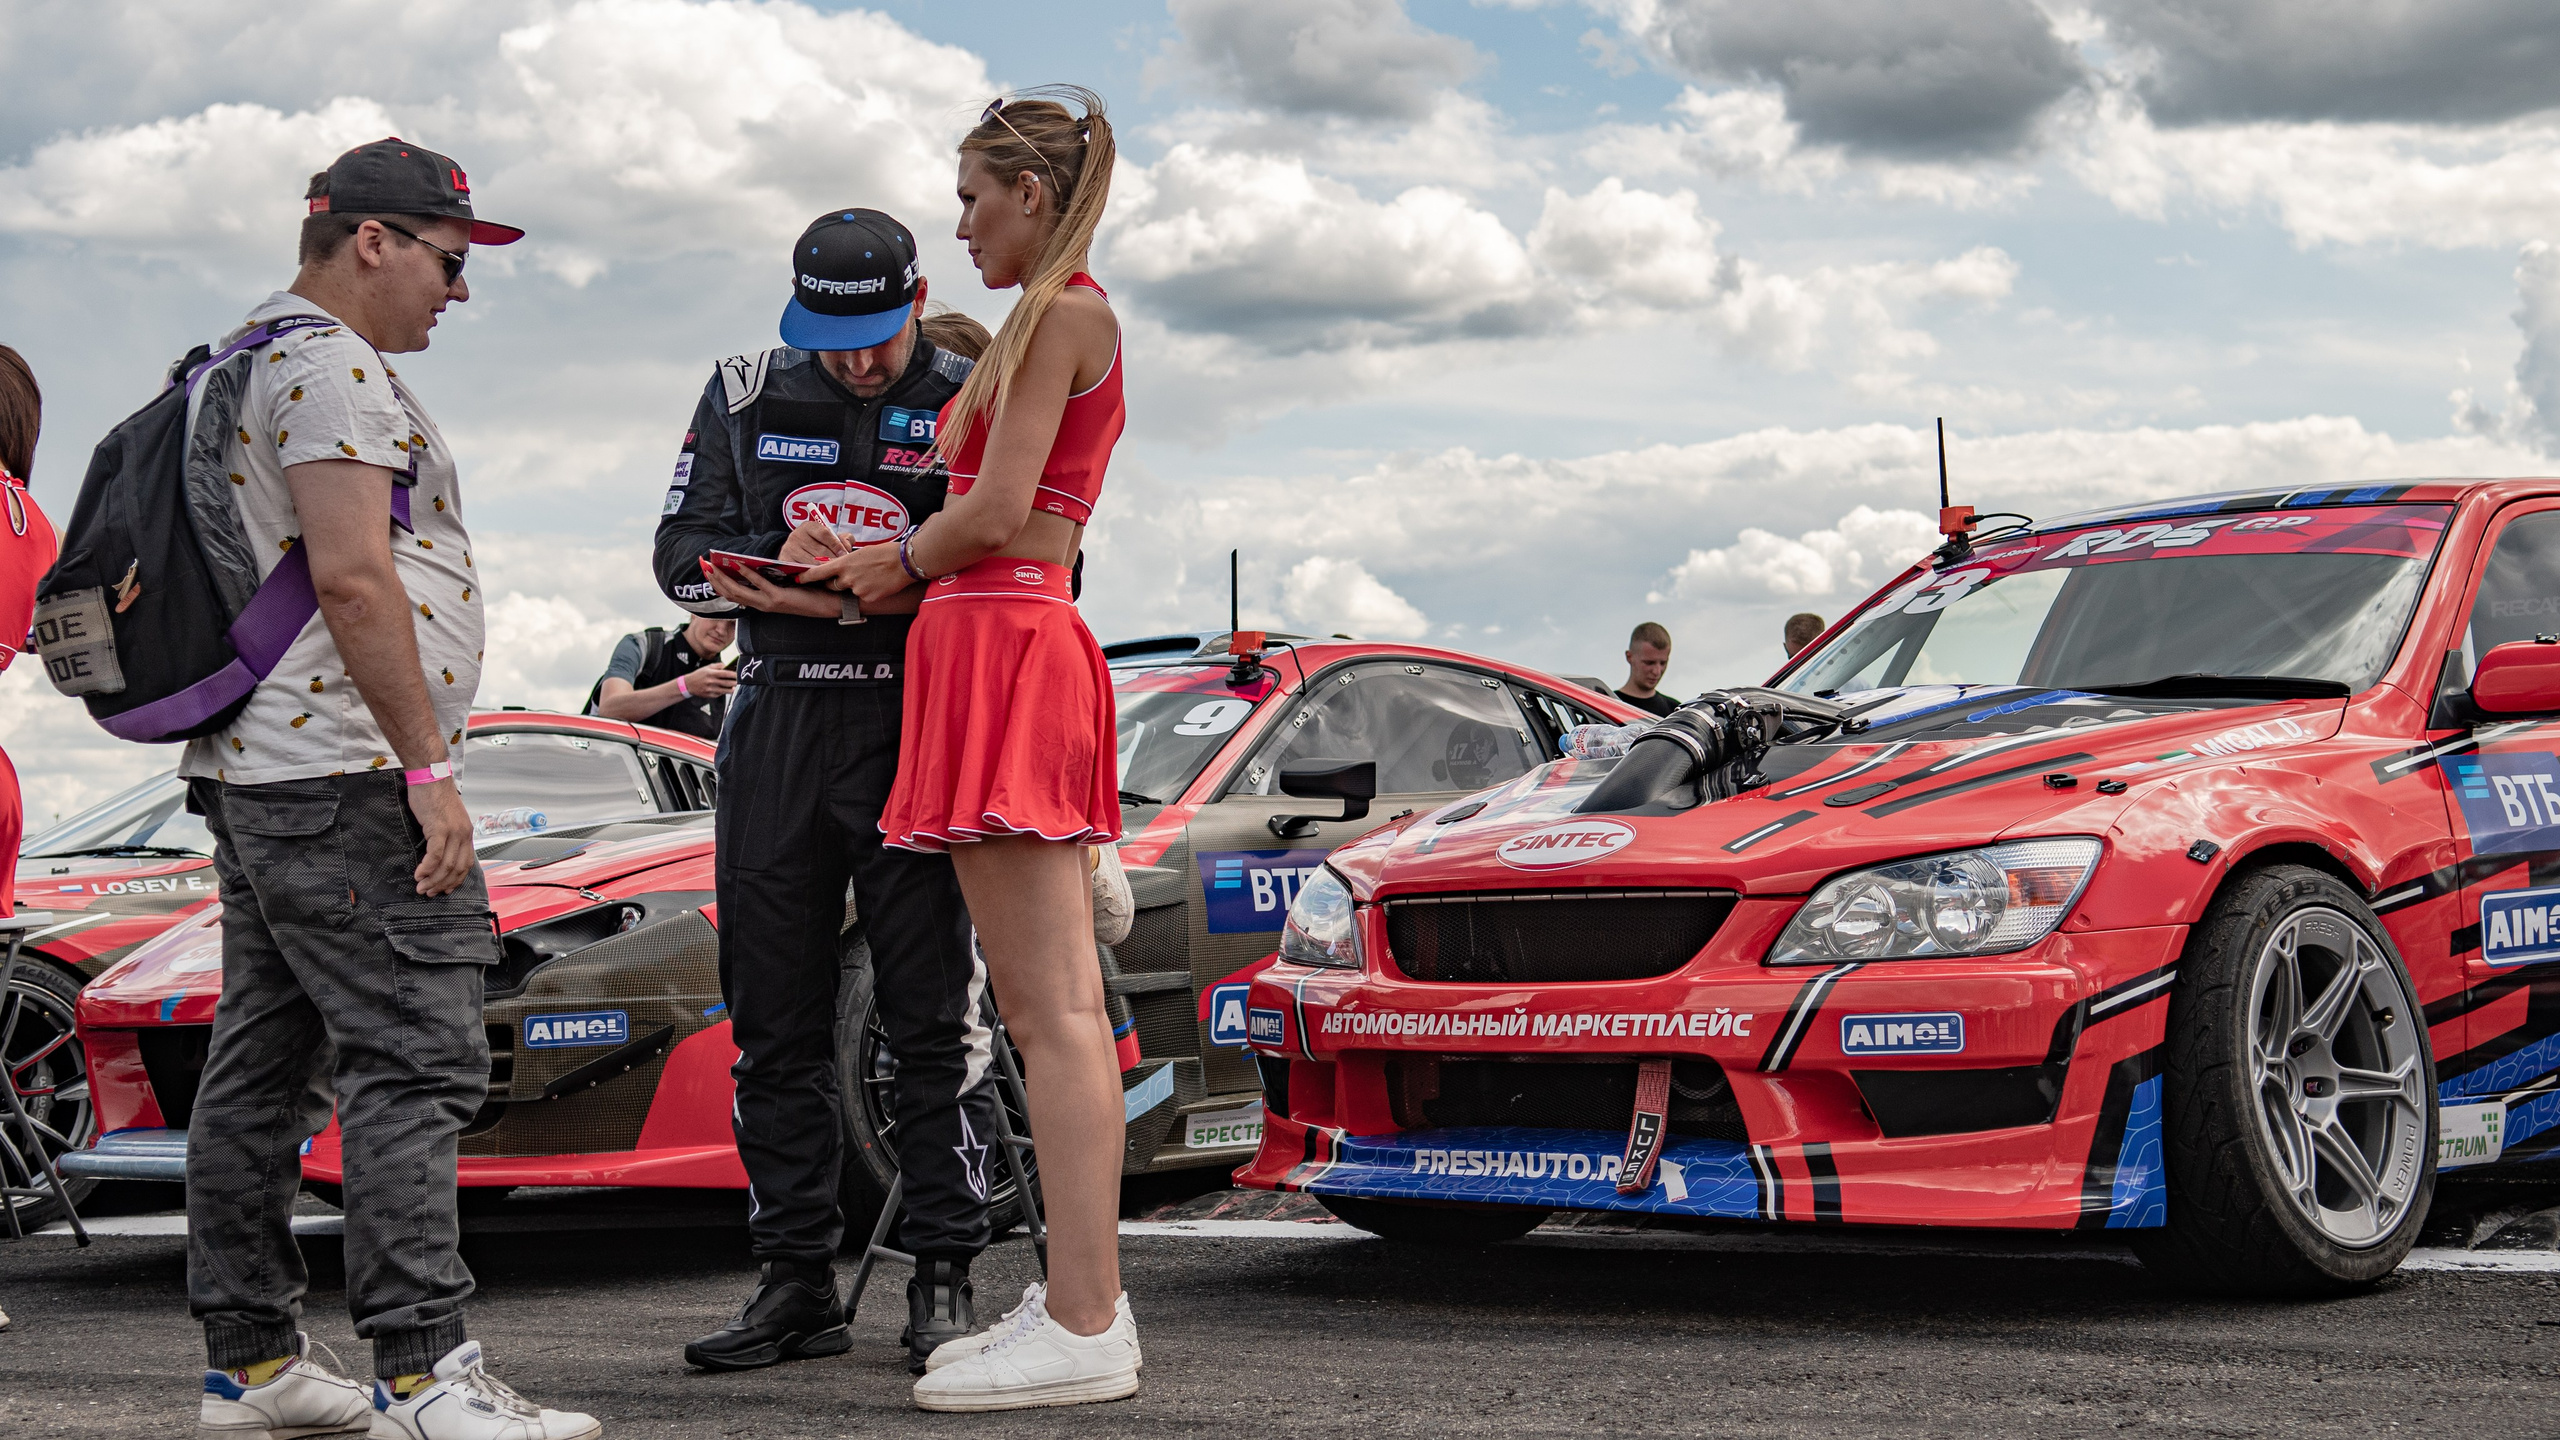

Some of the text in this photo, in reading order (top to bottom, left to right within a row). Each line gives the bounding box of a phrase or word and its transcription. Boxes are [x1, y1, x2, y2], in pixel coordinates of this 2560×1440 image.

[911, 419, 937, 438] ВТ
[761, 440, 834, 460] AIMOL
[879, 464, 911, 473] RUSSIAN
[2042, 516, 2311, 560] RDS GP
[1015, 571, 1043, 580] SINTEC
[2491, 596, 2560, 618] RECA
[798, 663, 893, 679] MIGAL D.
[1173, 699, 1253, 736] 9
[2191, 718, 2312, 757] MIGAL D.
[1506, 832, 1626, 852] SINTEC
[91, 877, 211, 895] LOSEV E.
[1249, 868, 1317, 912] ВТ
[529, 1019, 622, 1040] AIMOL
[1251, 1016, 1282, 1037] AIMOL
[1321, 1007, 1754, 1037] АВТОМОБИЛЬНЫЙ МАРКЕТПЛЕЙС
[1847, 1023, 1957, 1046] AIMOL
[1193, 1123, 1262, 1145] SPECT
[1412, 1150, 1622, 1181] FRESHAUTO.R
[2394, 1124, 2417, 1193] POWER
[463, 1351, 480, 1364] adidas
[470, 1401, 493, 1413] adidas
